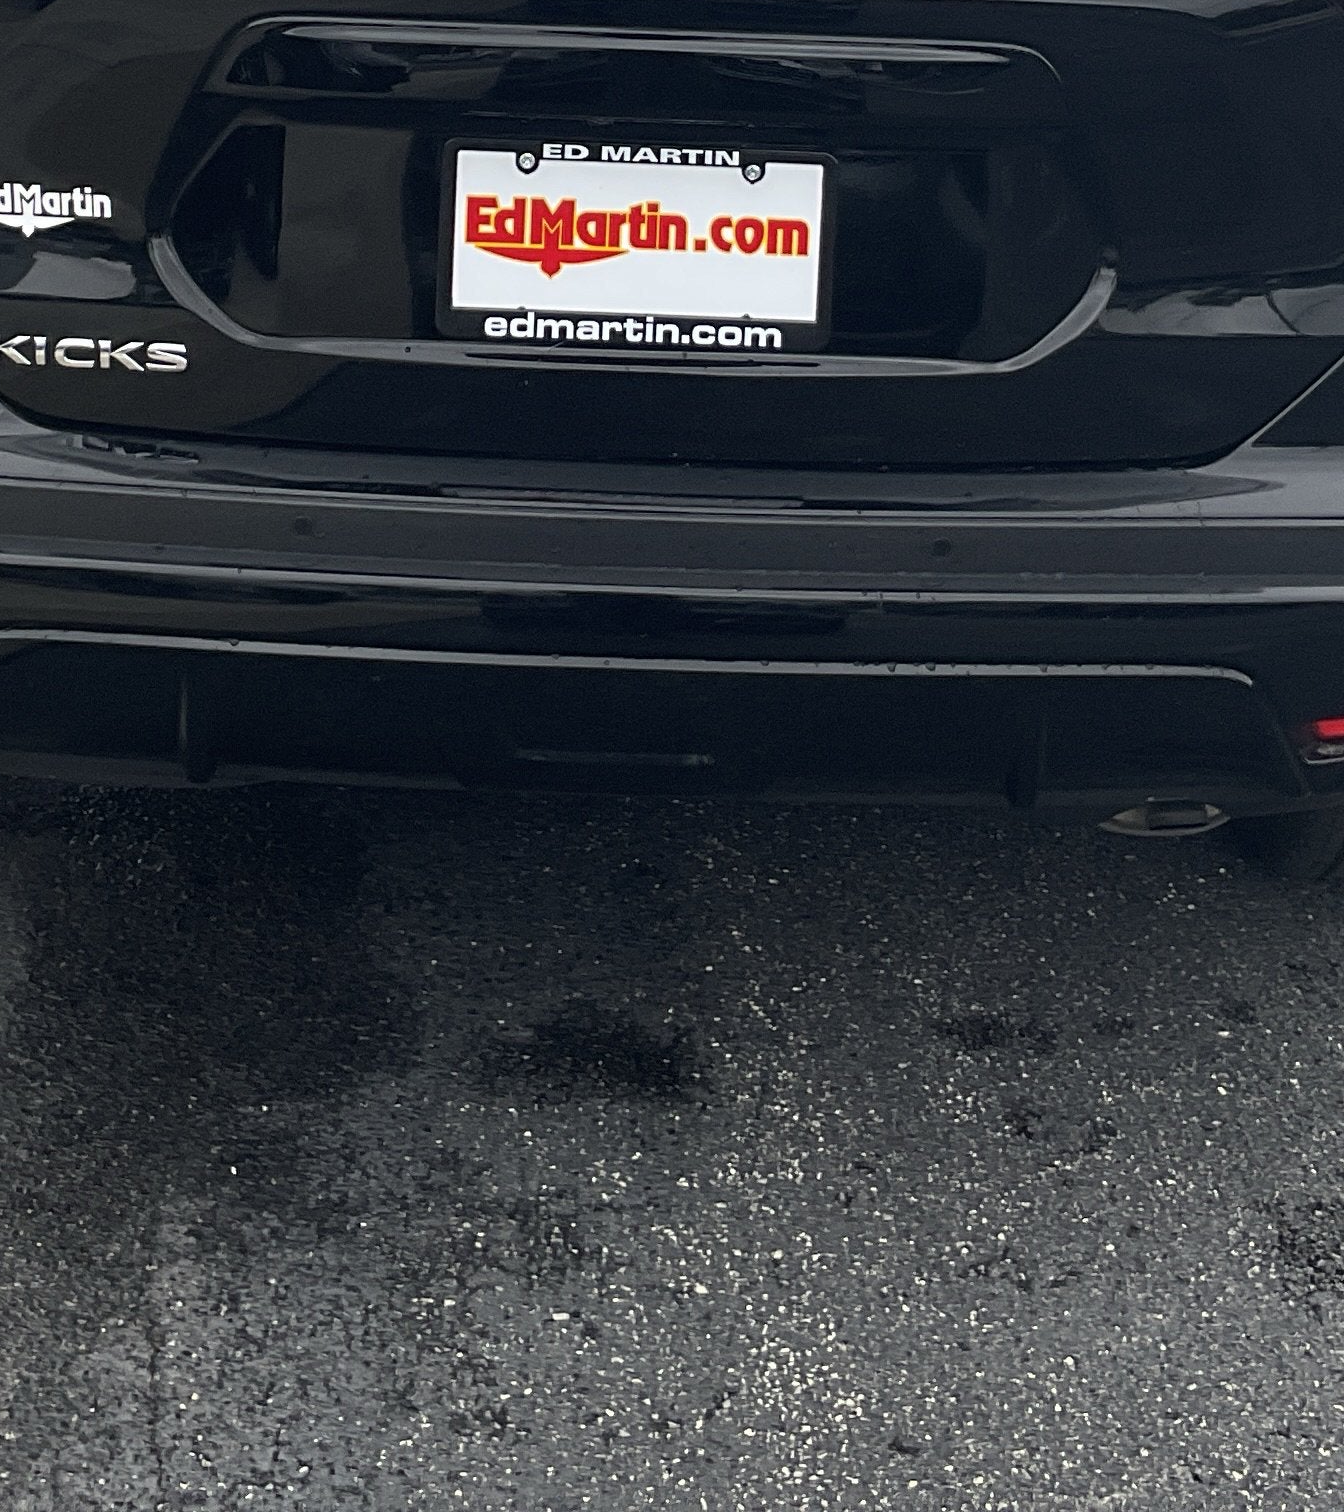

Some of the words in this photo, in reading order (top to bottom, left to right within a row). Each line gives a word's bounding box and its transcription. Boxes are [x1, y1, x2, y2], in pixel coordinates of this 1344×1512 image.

[542, 143, 590, 162] ED
[601, 145, 741, 167] MARTIN
[464, 194, 810, 258] EdMartin.com
[483, 311, 783, 349] edmartin.com
